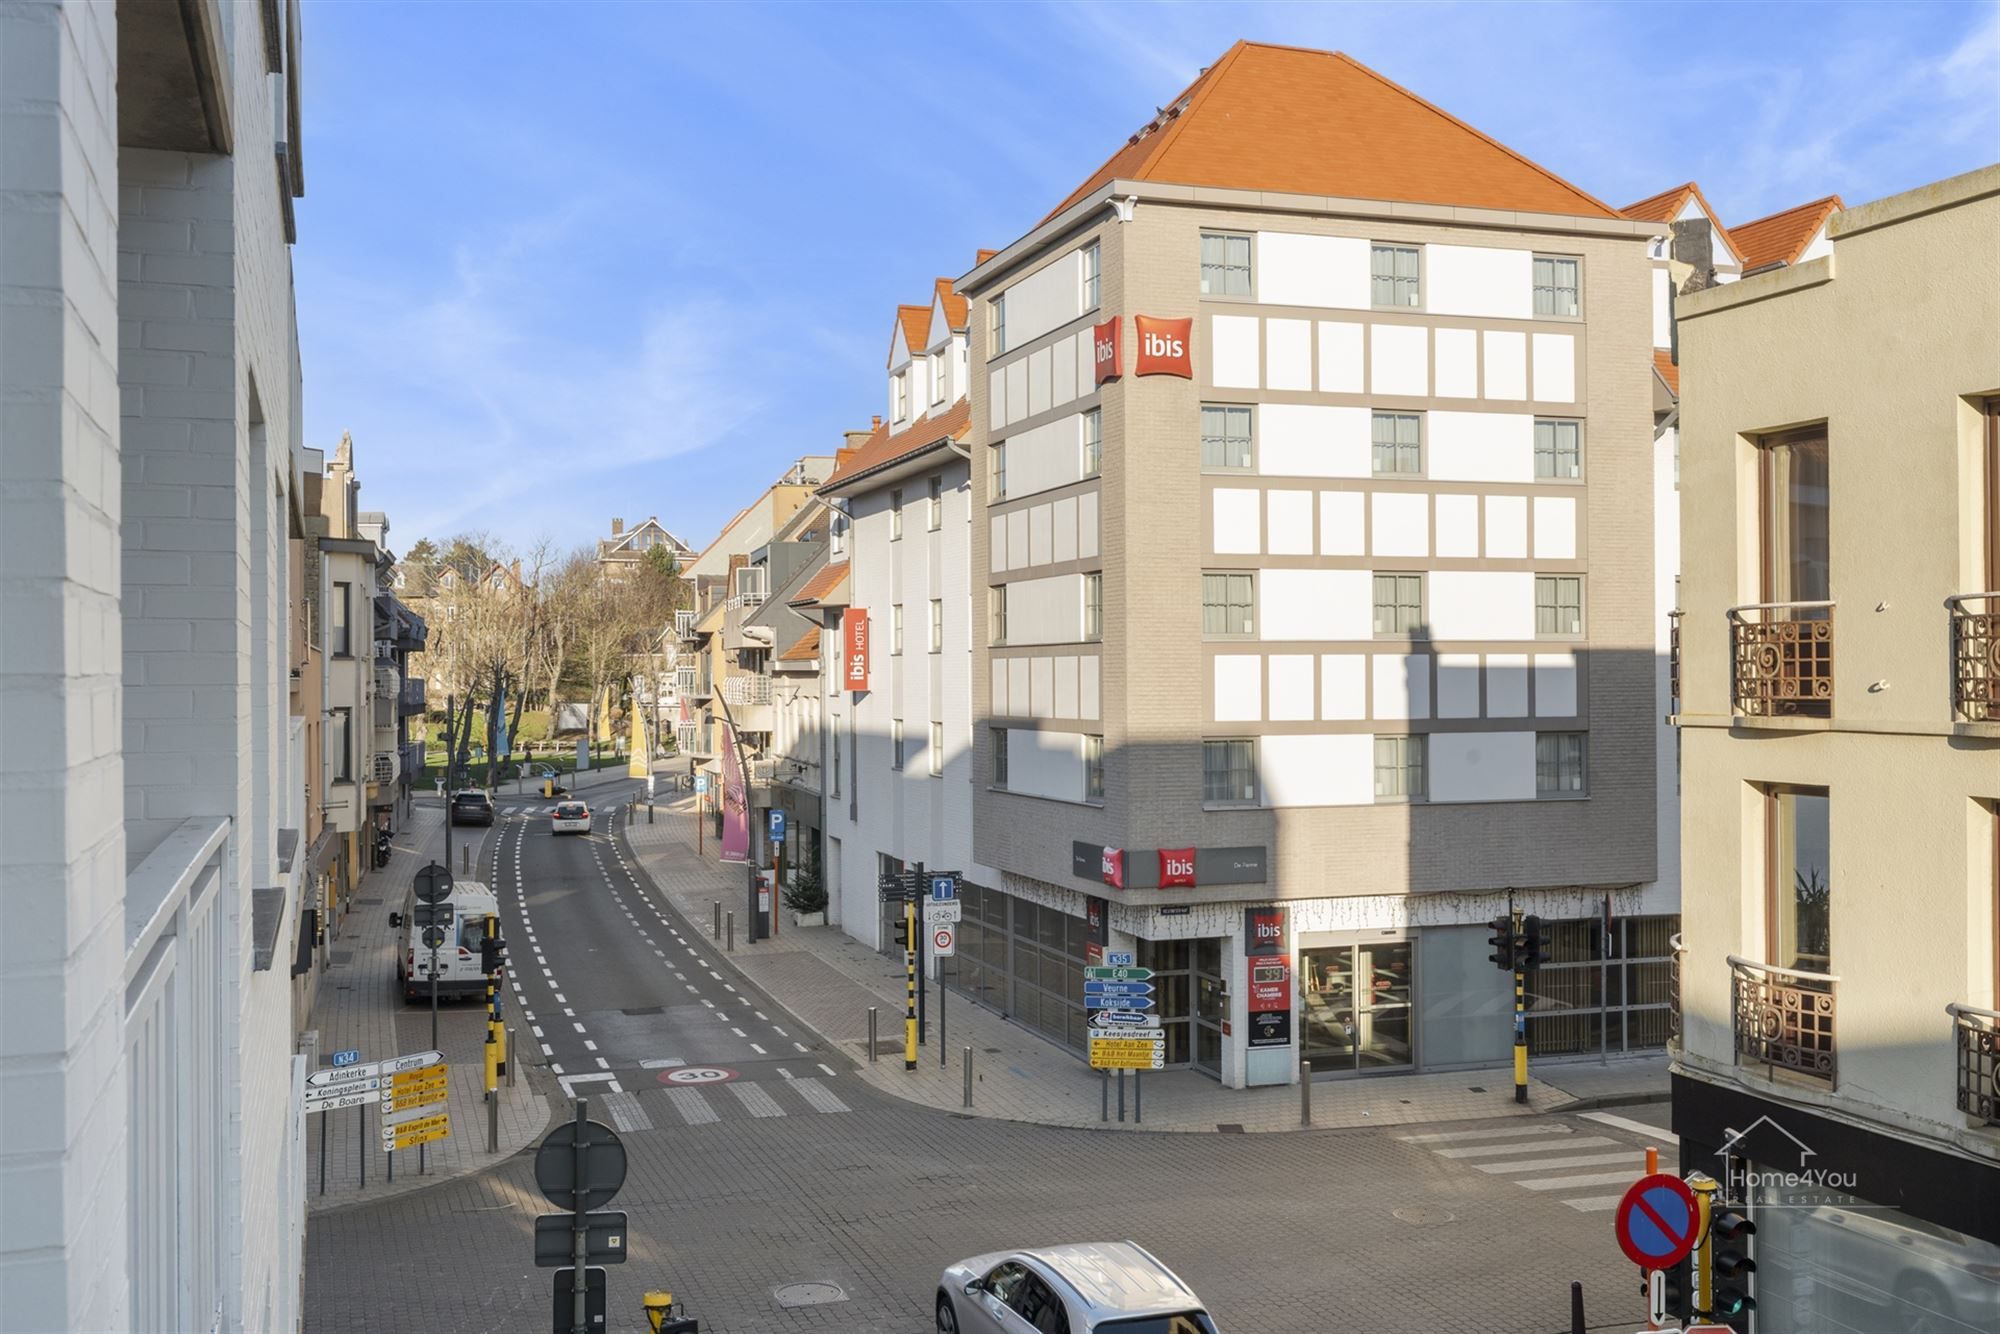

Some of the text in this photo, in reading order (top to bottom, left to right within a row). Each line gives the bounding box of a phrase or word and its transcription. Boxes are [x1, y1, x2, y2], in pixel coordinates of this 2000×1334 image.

[1096, 338, 1113, 364] ibis
[1145, 333, 1184, 357] ibis
[850, 619, 865, 680] ibis HOTEL
[771, 814, 782, 829] P
[1167, 859, 1193, 875] ibis
[1257, 923, 1281, 937] ibis
[1113, 969, 1128, 978] E40
[1103, 983, 1128, 992] Veurne
[1101, 998, 1131, 1008] Koksijde
[1103, 1031, 1151, 1039] Keesjesdreef
[339, 1052, 354, 1063] N34
[396, 1058, 423, 1070] Centrum
[329, 1068, 366, 1081] Adinkerke
[678, 1070, 721, 1081] 30
[317, 1083, 366, 1097] Koningsplein
[322, 1096, 365, 1109] De Boare
[409, 1135, 428, 1145] Sfinx
